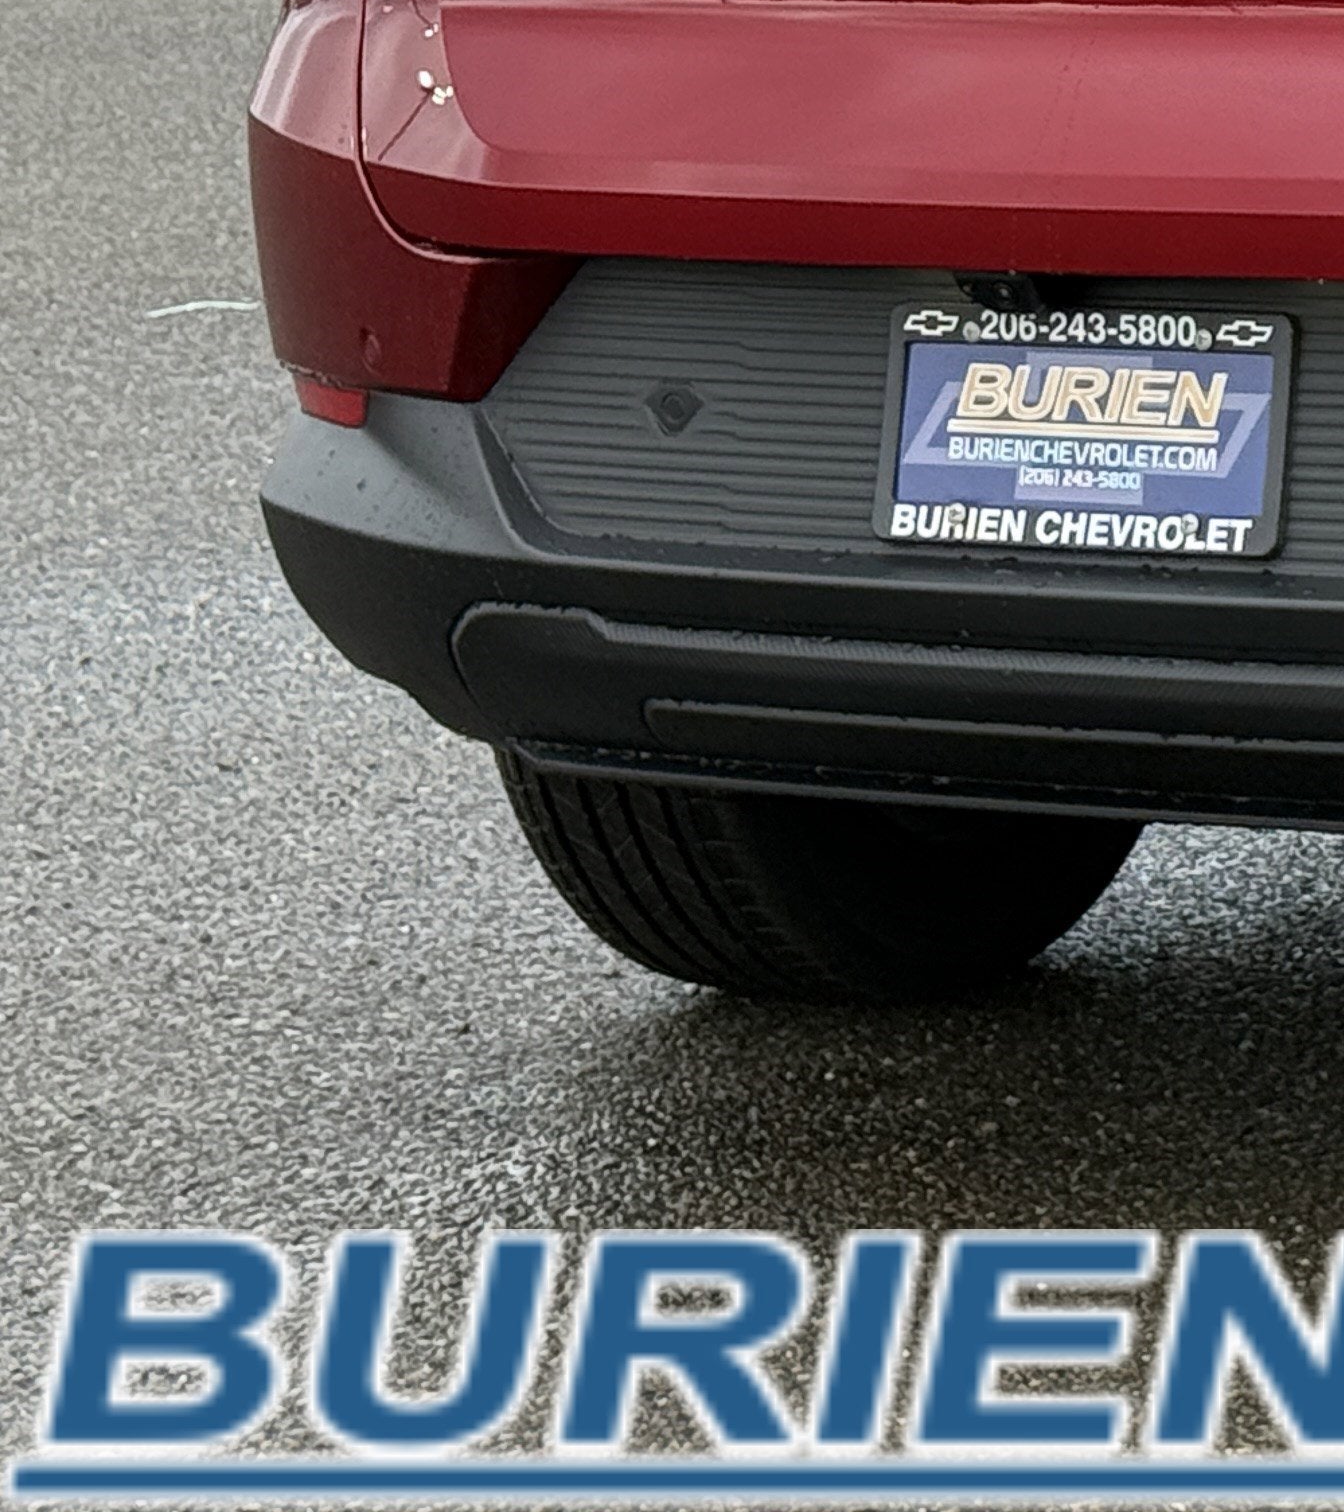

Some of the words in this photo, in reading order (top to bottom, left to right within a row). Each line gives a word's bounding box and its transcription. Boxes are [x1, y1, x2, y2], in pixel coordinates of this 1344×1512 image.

[979, 308, 1197, 347] 206-243-5800
[954, 362, 1229, 428] BURIEN
[948, 437, 1217, 472] BURIENCHEVROLET.COM
[1018, 467, 1059, 487] (206)
[1062, 469, 1141, 490] 243-5800
[890, 503, 1026, 543] BURIEN
[1035, 509, 1252, 553] CHEVROLET
